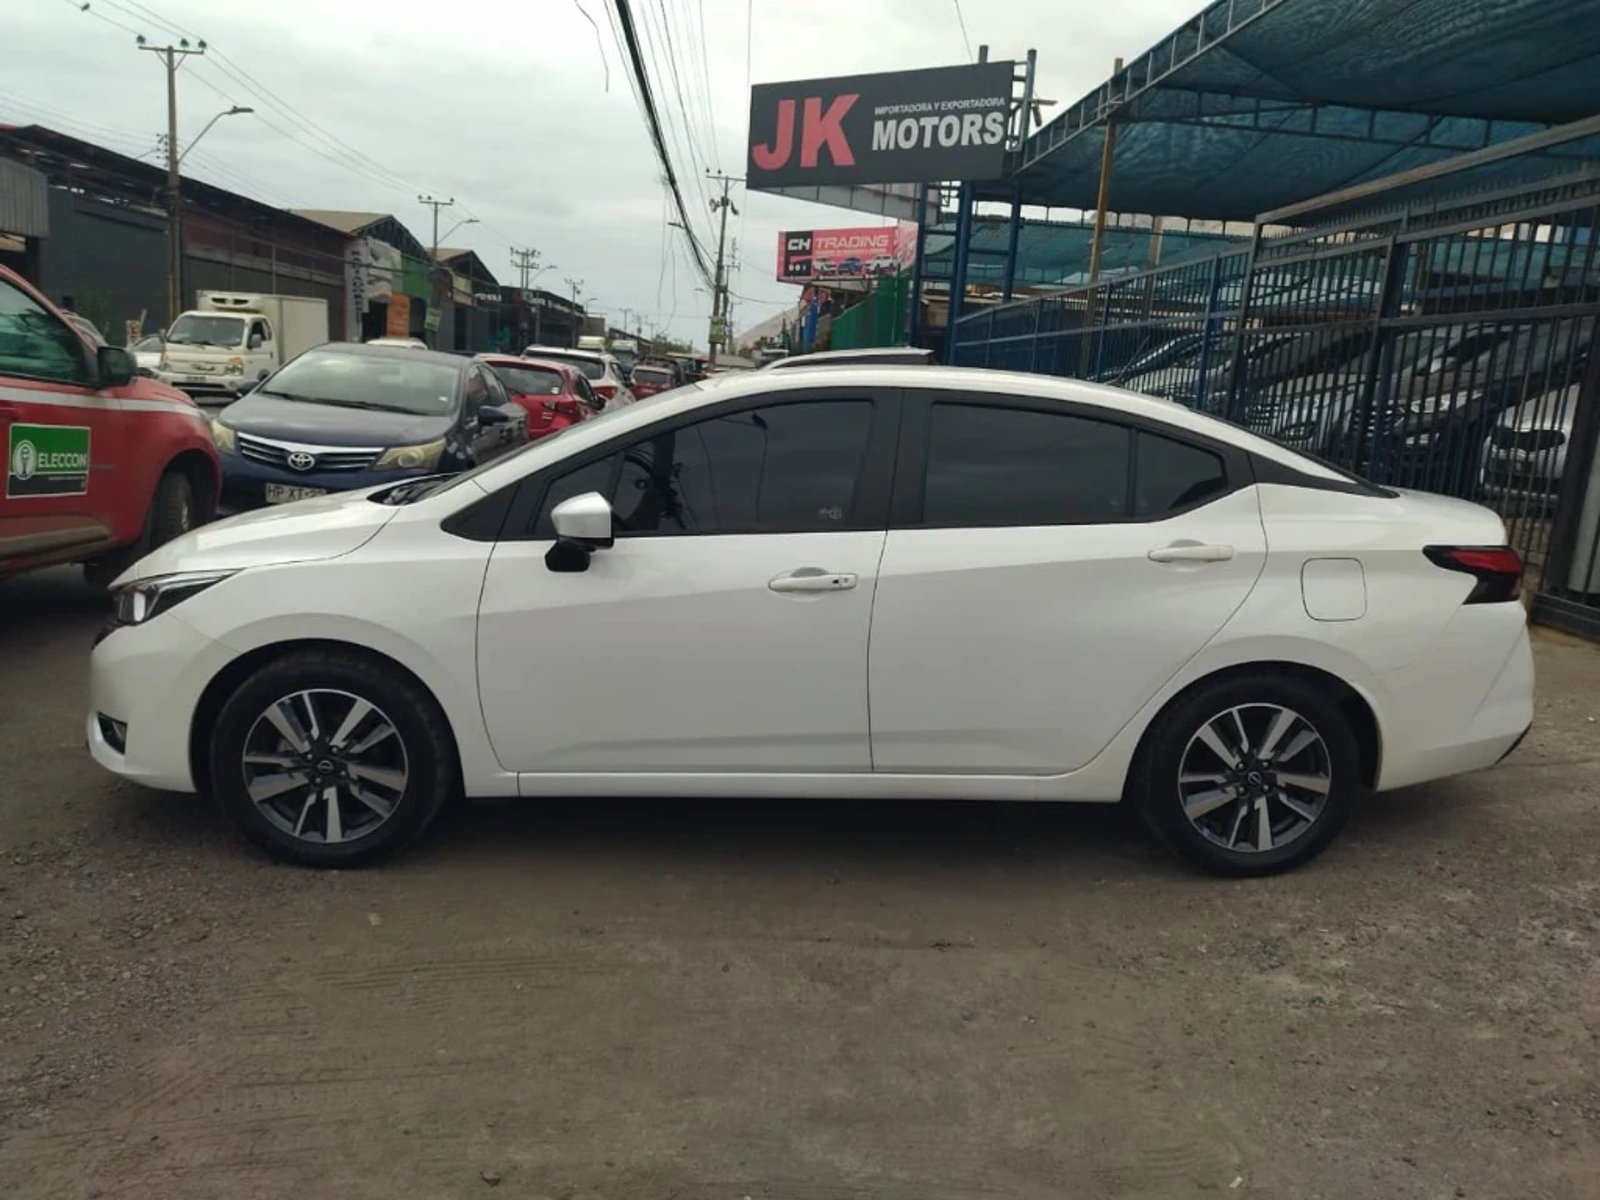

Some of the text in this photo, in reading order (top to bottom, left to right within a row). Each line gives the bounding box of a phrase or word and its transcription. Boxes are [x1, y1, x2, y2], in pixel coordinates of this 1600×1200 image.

[874, 97, 1005, 116] IMPORTADORA Y EXPORTADORA
[752, 94, 860, 171] JK
[872, 112, 1004, 151] MOTORS
[787, 235, 888, 251] CH TRADING
[38, 452, 87, 469] ELECCON
